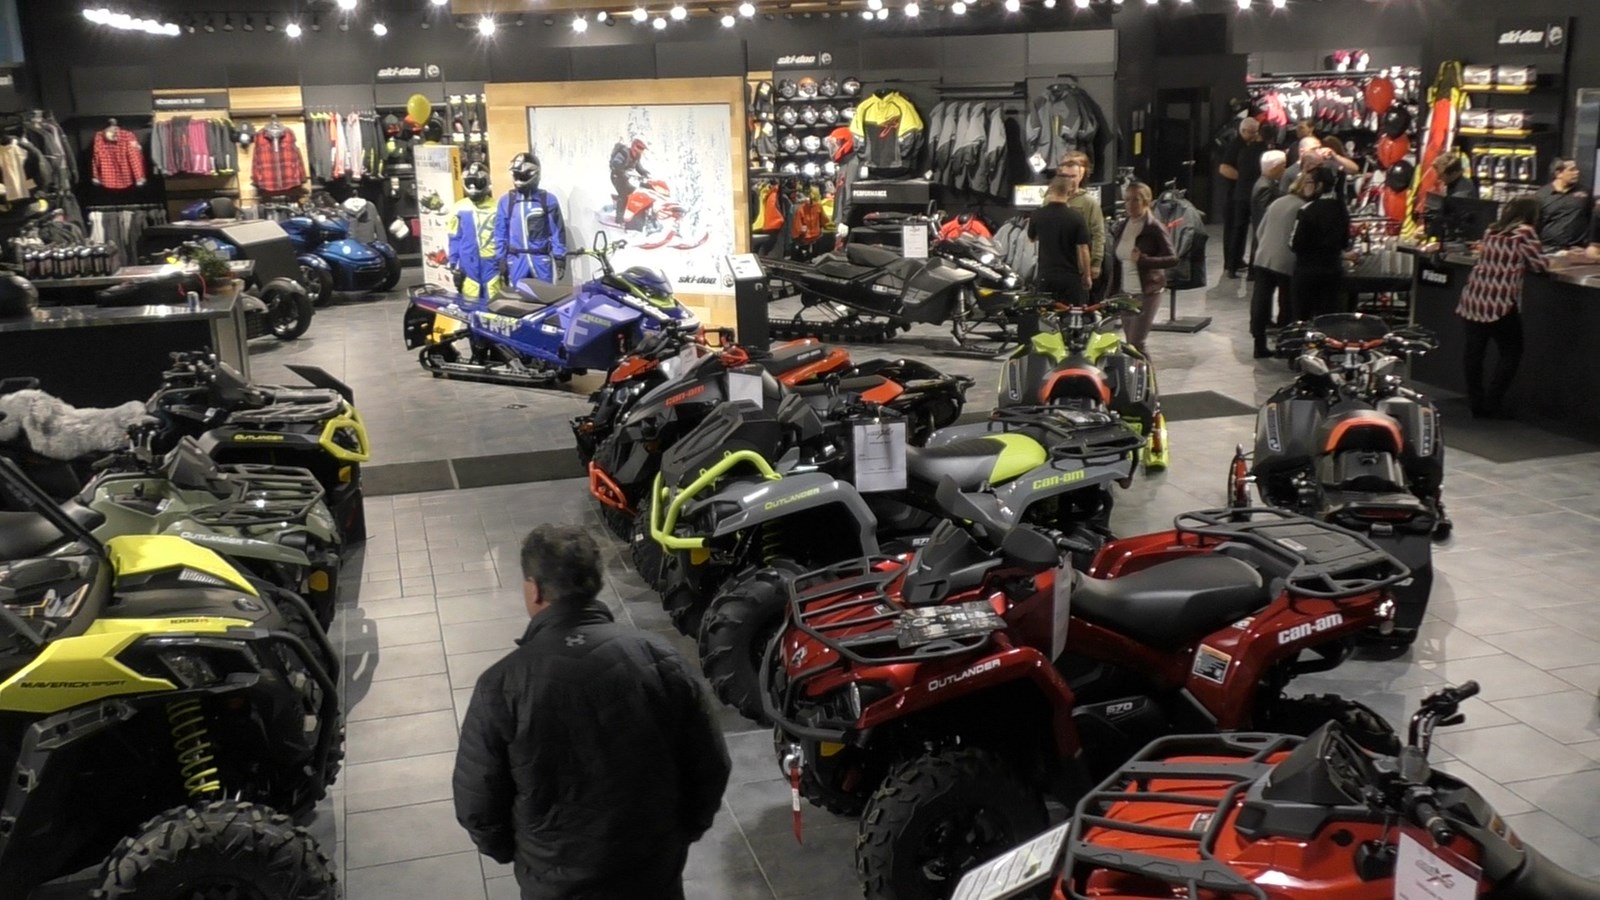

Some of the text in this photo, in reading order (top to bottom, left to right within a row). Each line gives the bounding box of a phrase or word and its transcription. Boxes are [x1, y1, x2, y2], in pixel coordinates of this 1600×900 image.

[1497, 29, 1545, 44] ski-doo
[776, 54, 816, 65] ski-doo
[852, 190, 888, 198] PERFORMANCE
[677, 275, 718, 285] ski-doo
[665, 384, 705, 406] can-am
[1032, 469, 1085, 490] can-am
[764, 487, 820, 511] OUTLANDER
[180, 531, 243, 546] OUTLANDER
[1277, 612, 1344, 645] can-am
[927, 658, 1001, 692] OUTLANDER
[1106, 702, 1133, 716] 570
